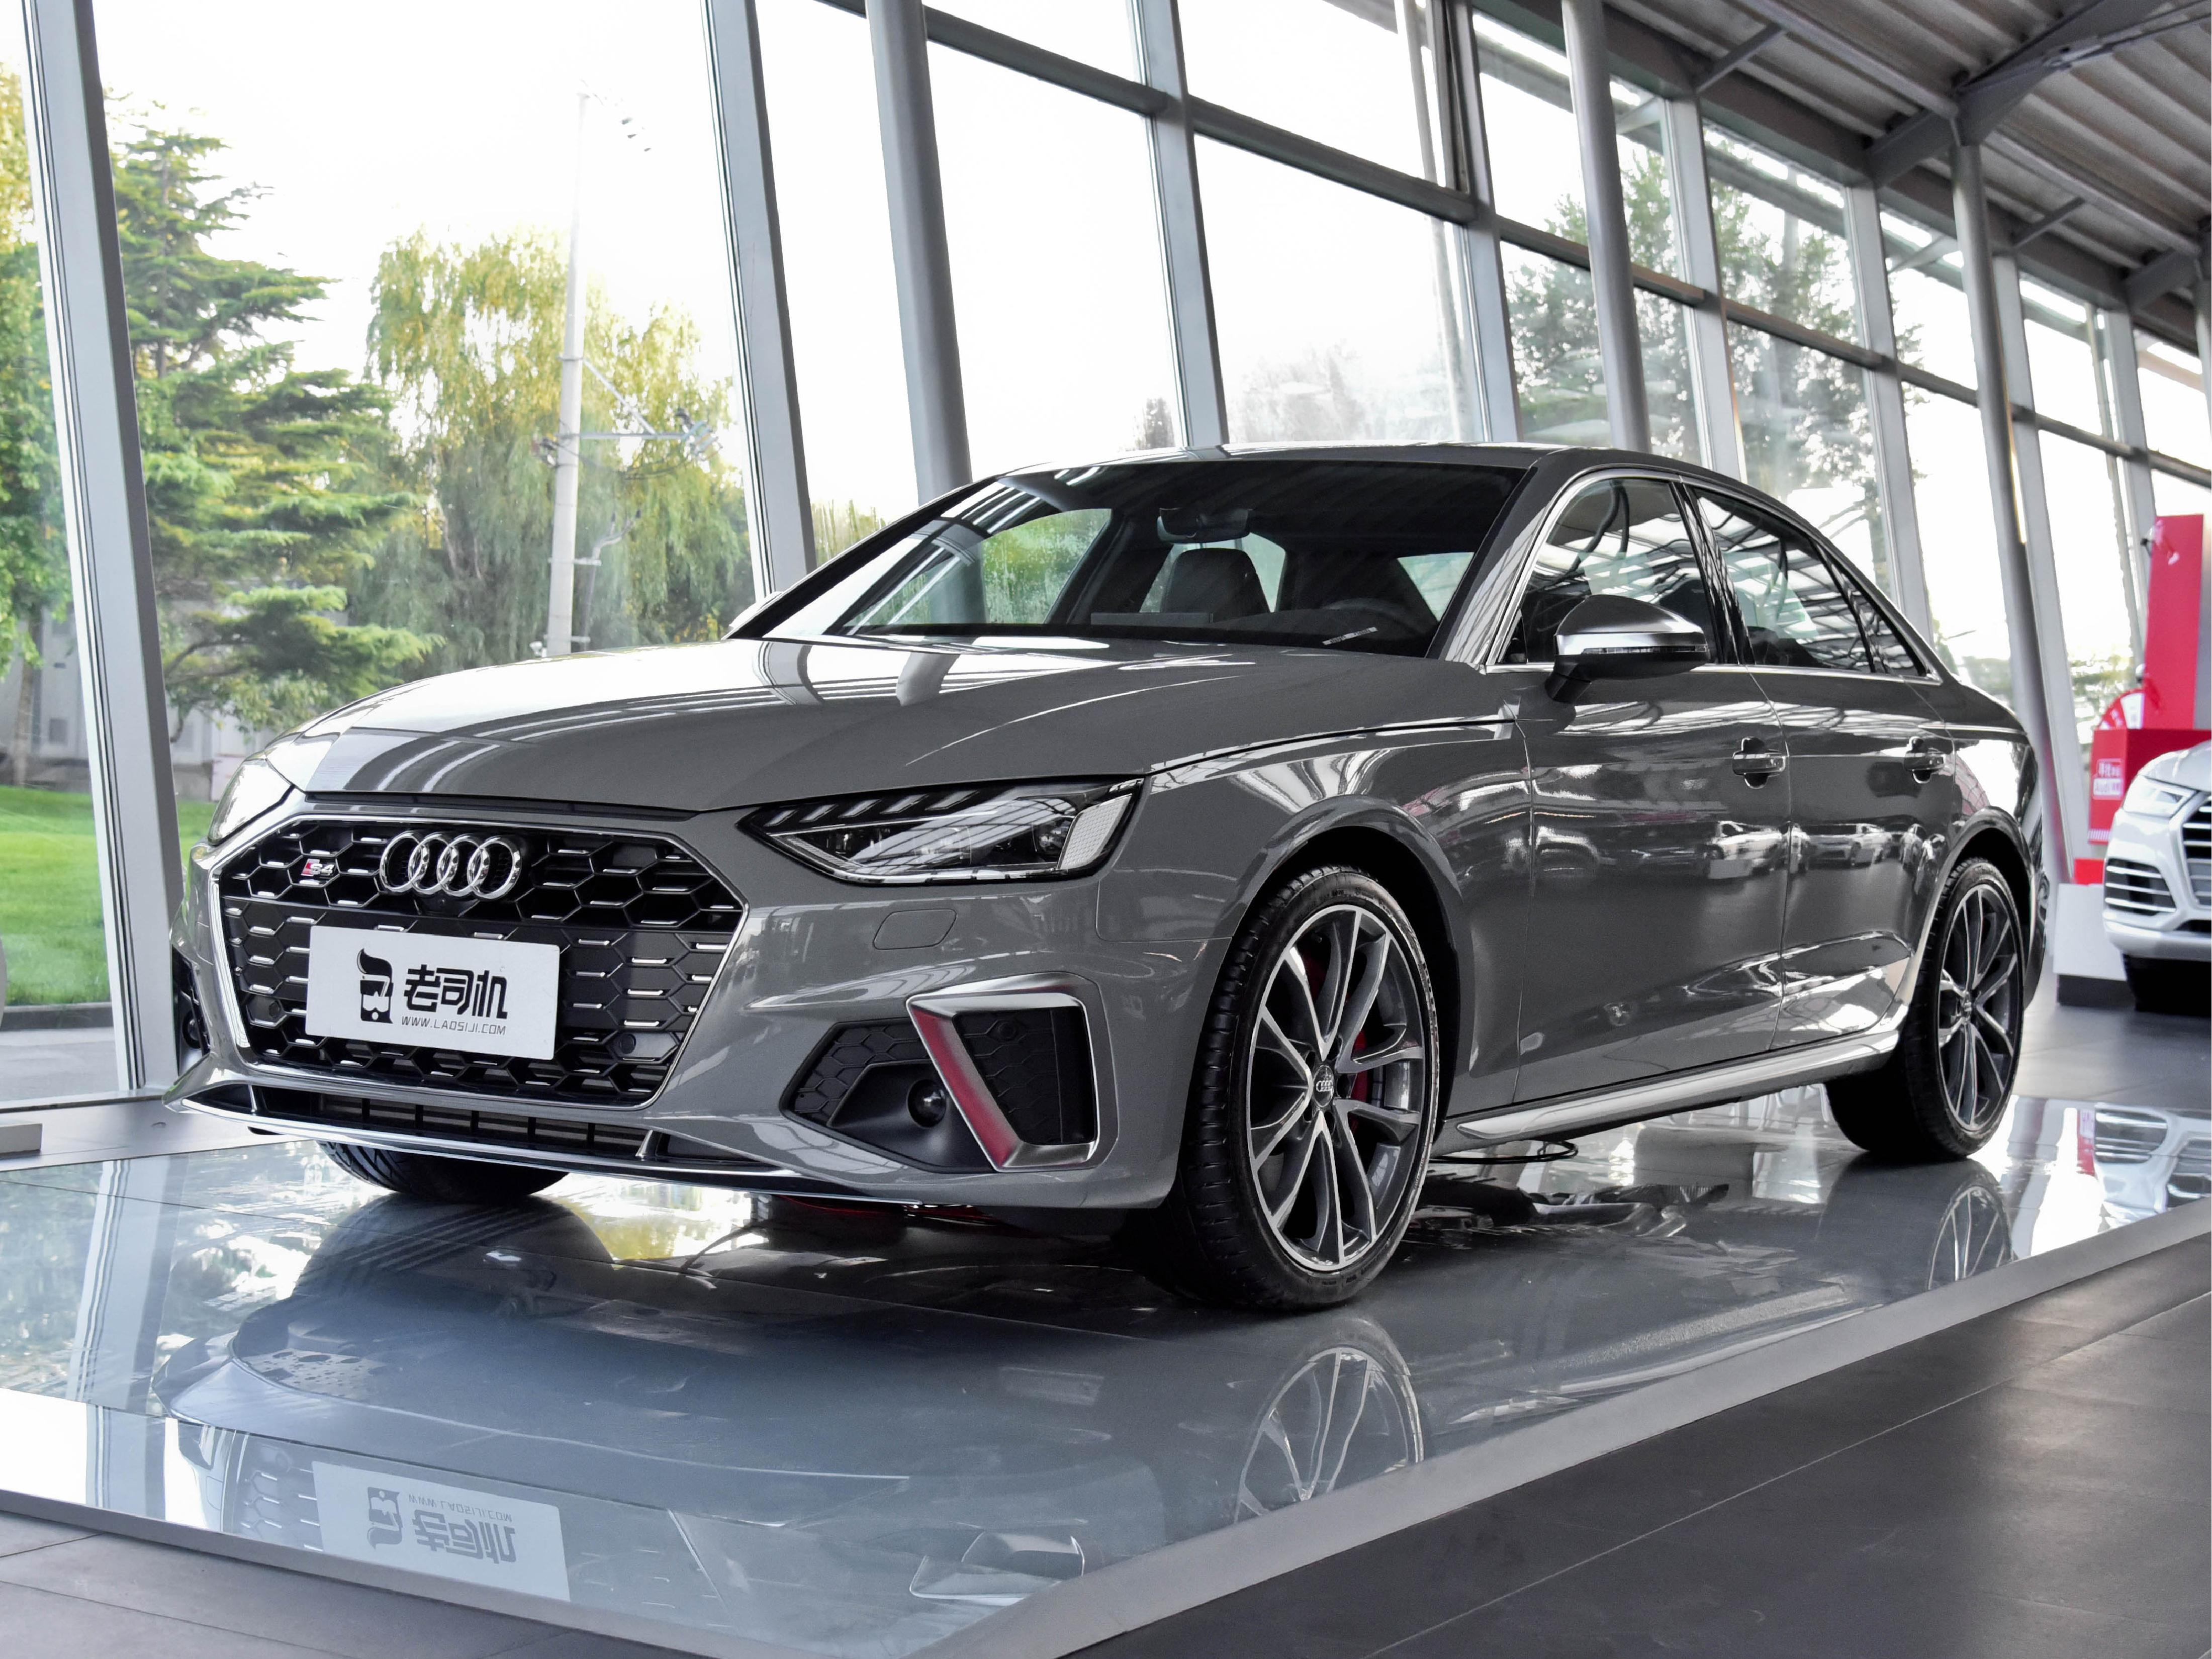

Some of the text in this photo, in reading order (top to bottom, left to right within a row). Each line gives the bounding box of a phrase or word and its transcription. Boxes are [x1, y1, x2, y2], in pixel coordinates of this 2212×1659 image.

[309, 863, 335, 876] S4
[404, 964, 508, 1019] 老司机
[402, 1016, 506, 1035] WWW.LAOSIJI.COM
